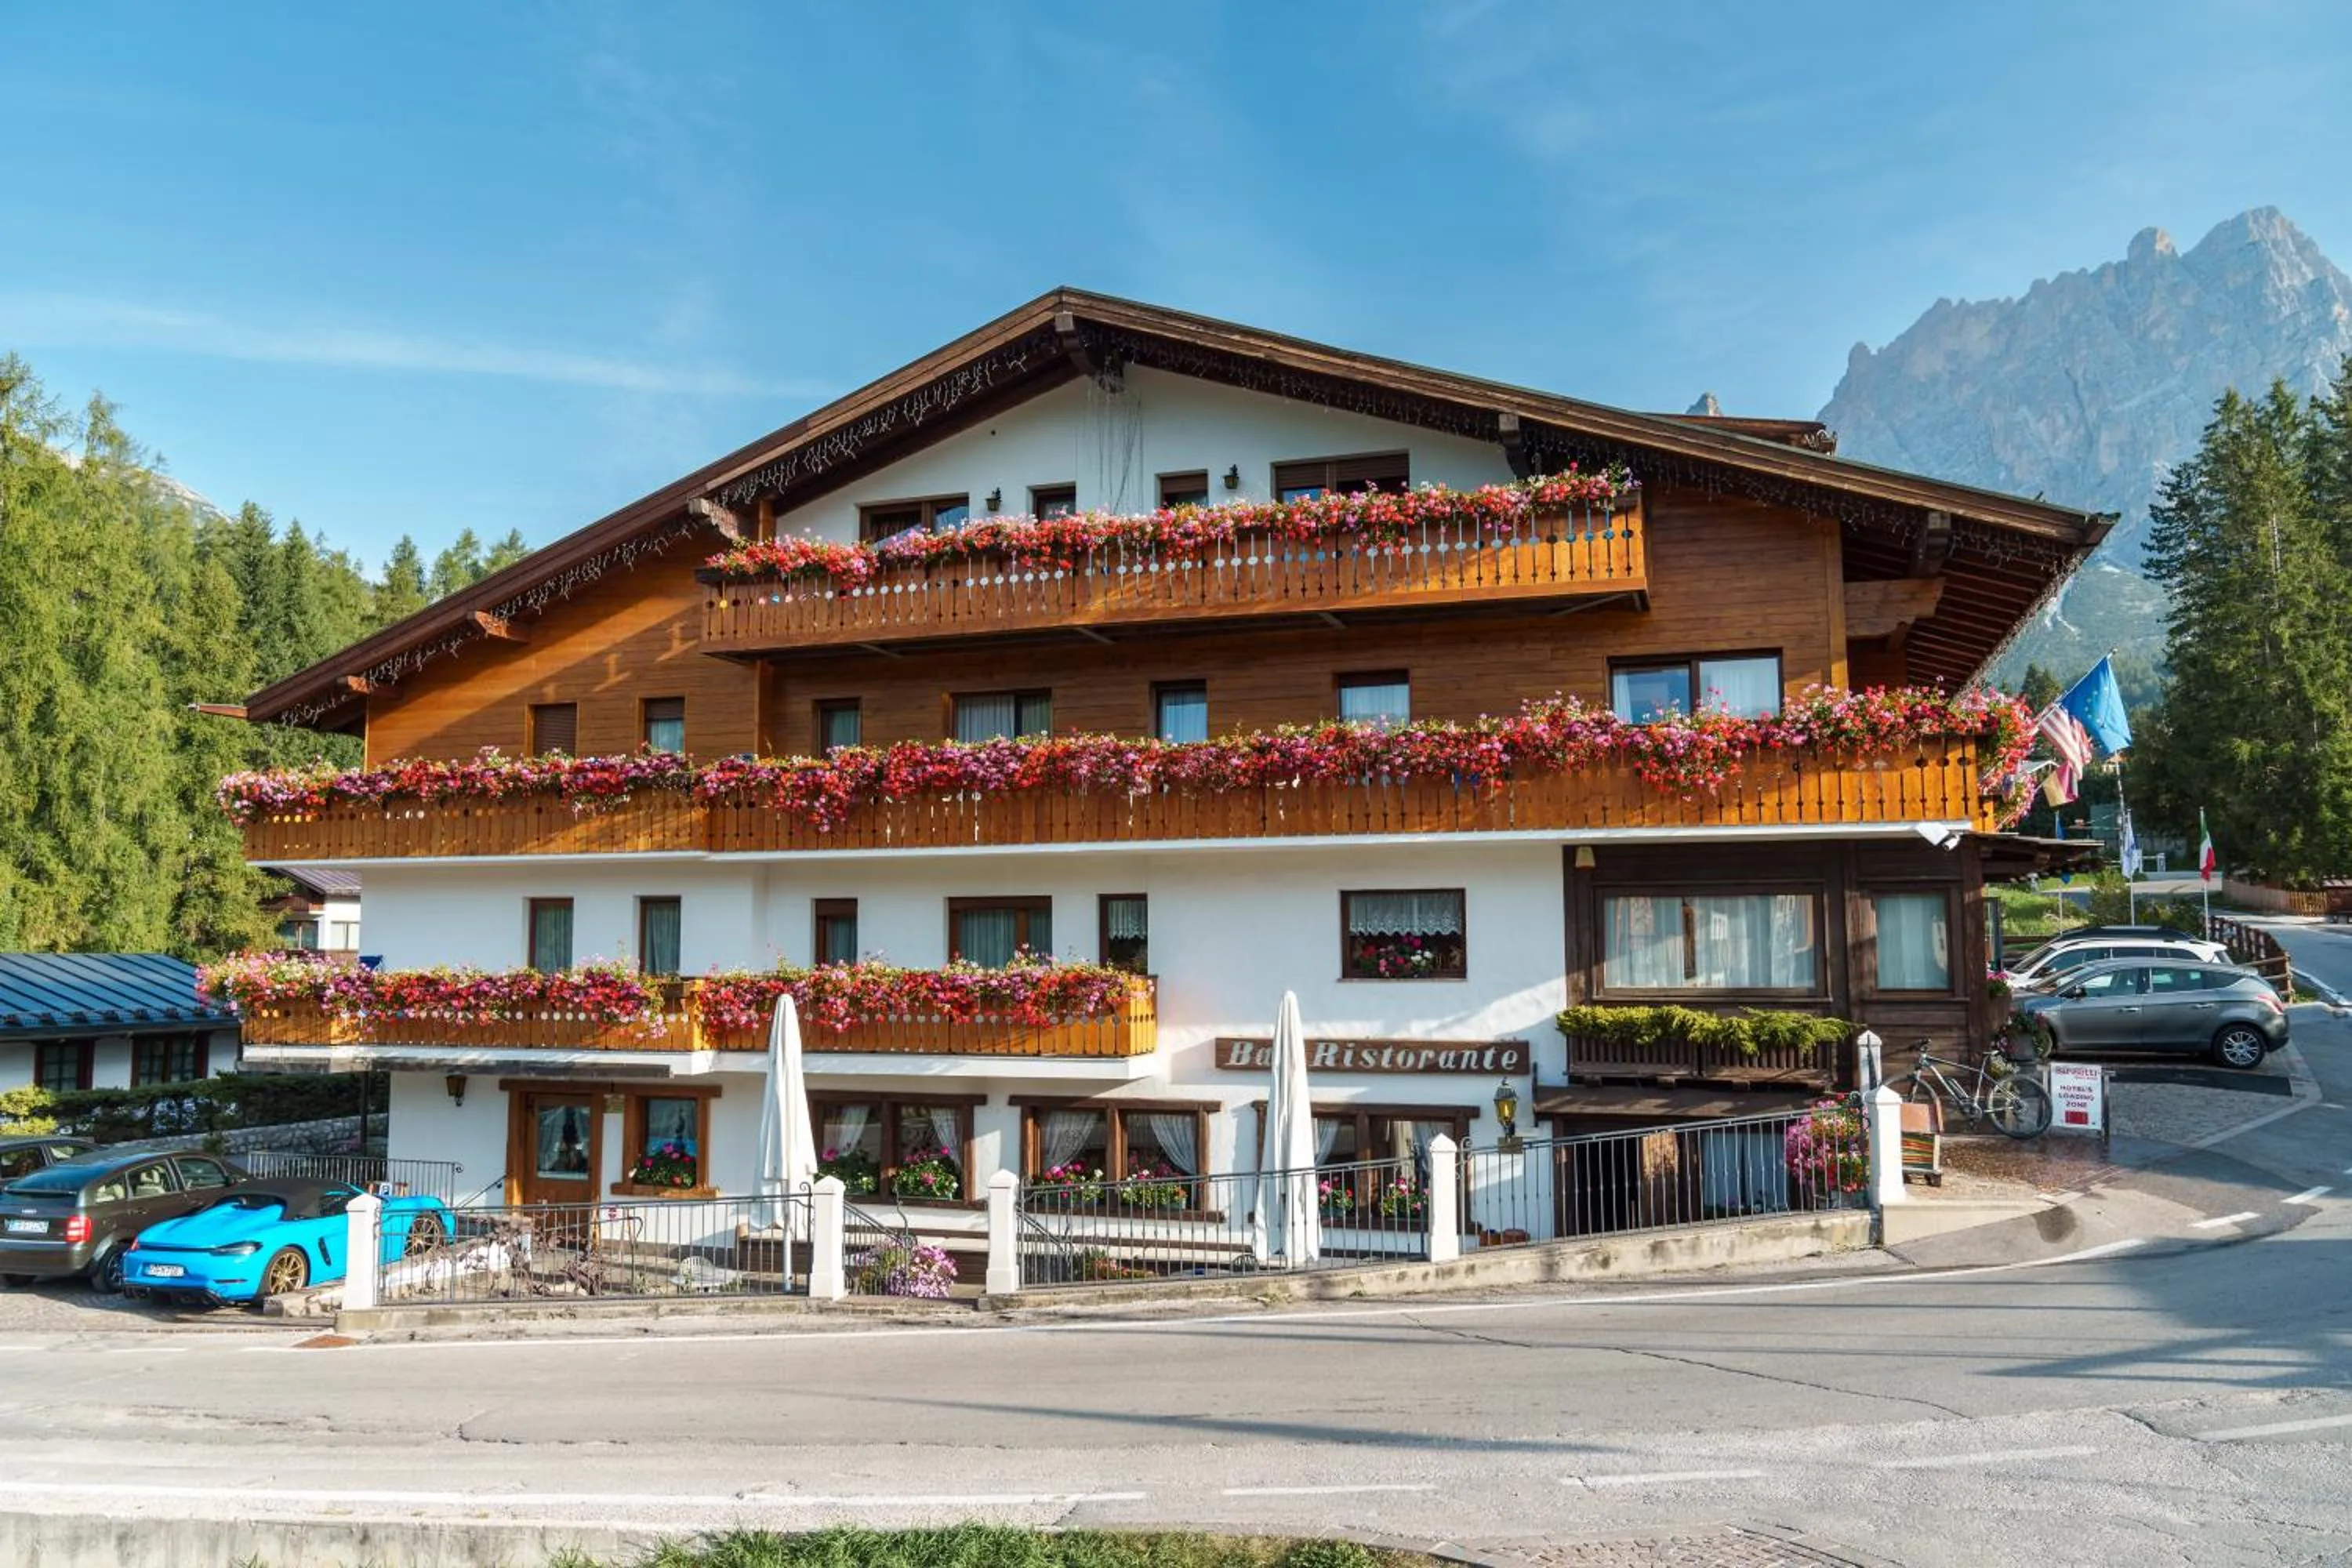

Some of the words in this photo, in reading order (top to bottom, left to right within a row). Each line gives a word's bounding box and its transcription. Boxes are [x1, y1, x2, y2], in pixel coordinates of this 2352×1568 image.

[1225, 1040, 1273, 1066] Ba
[1310, 1041, 1519, 1069] Ristorante
[2058, 1092, 2095, 1101] LOADING
